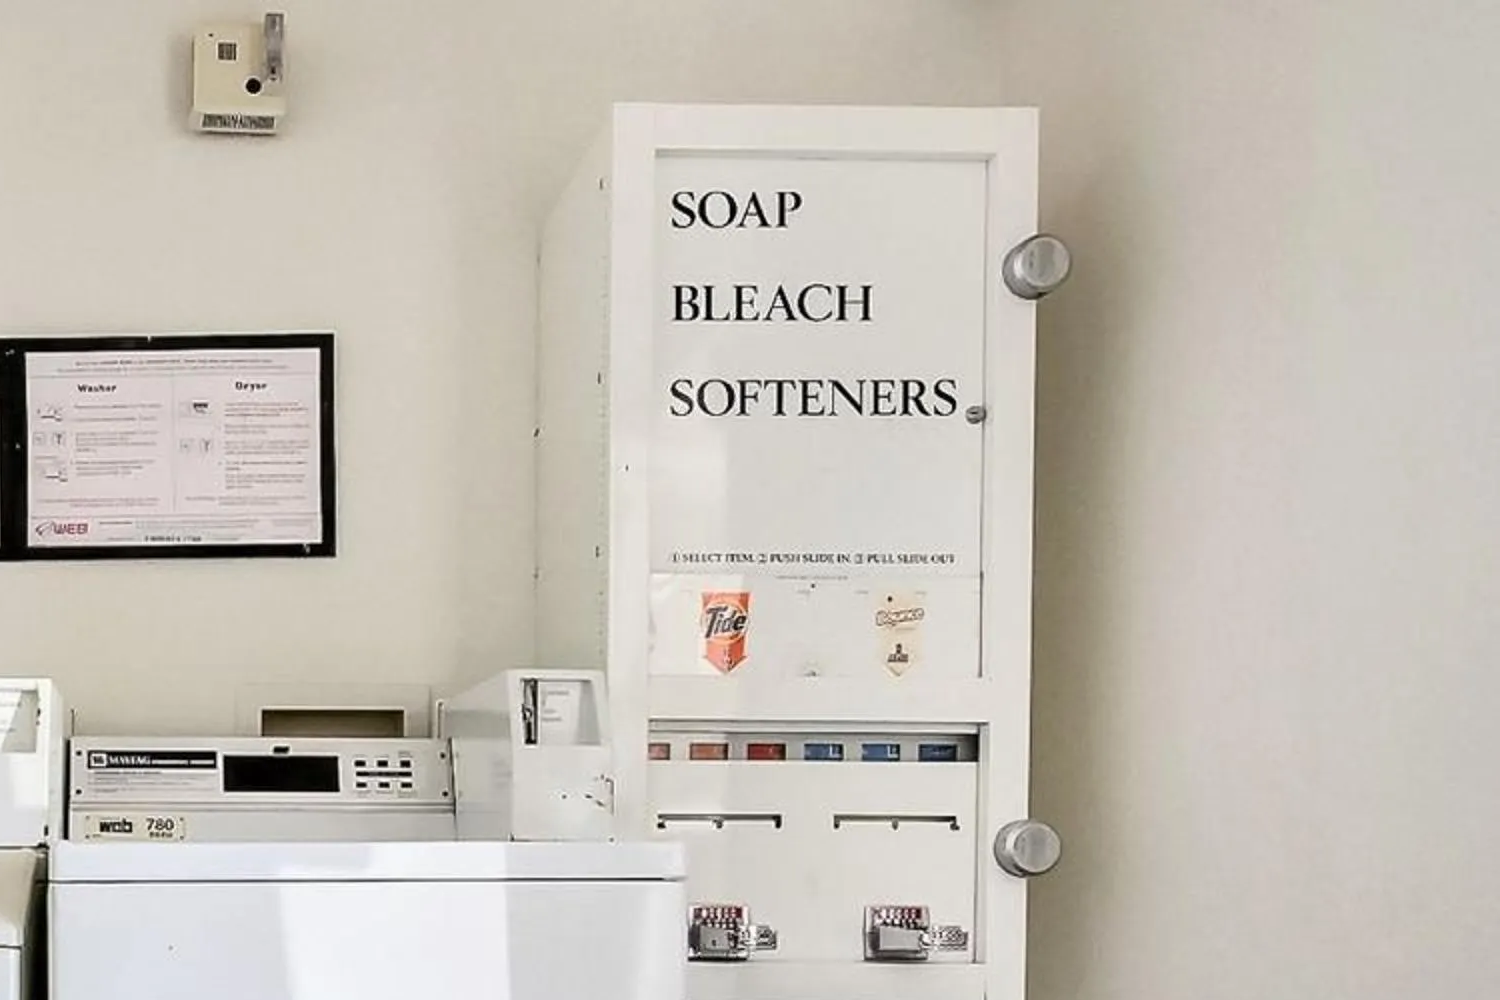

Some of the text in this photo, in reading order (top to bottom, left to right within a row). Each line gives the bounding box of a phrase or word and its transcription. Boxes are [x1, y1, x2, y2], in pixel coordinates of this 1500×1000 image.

[670, 190, 803, 229] SOAP
[672, 283, 874, 322] BLEACH
[77, 383, 118, 393] Washer
[235, 380, 268, 391] Dryer
[669, 378, 958, 418] SOFTENERS
[53, 522, 89, 535] WEB
[704, 605, 748, 639] Tide
[145, 817, 175, 831] 780
